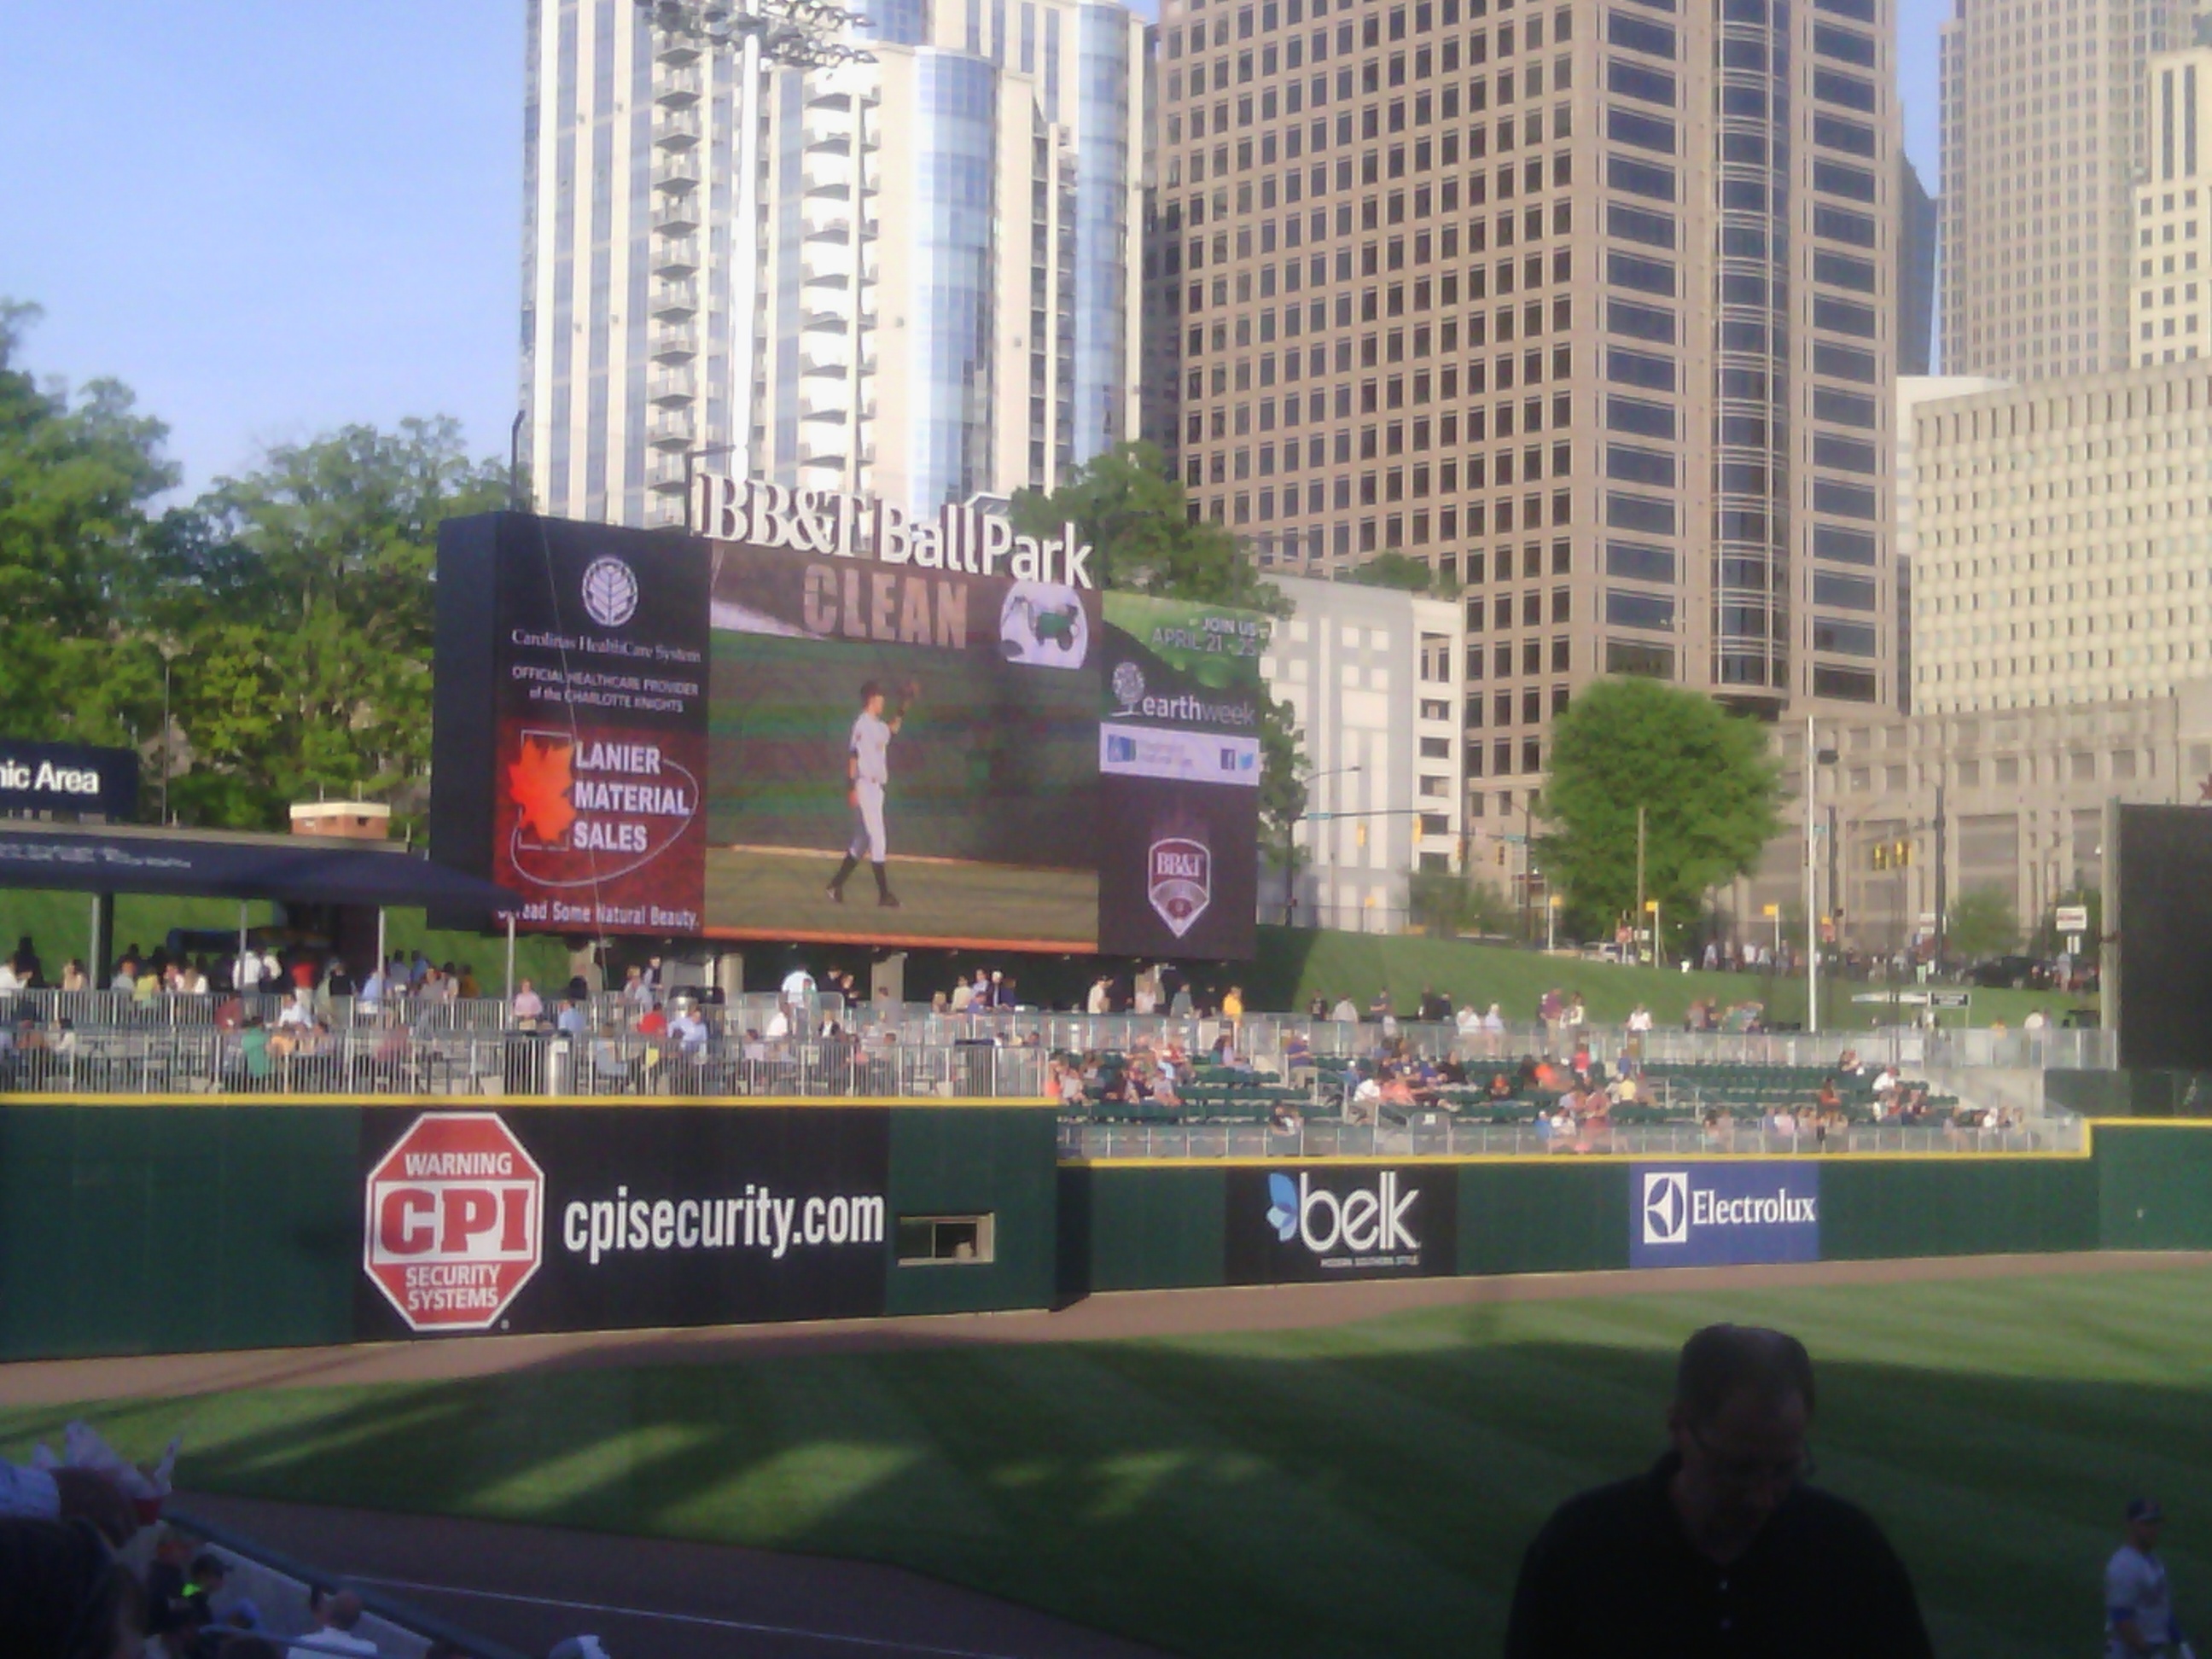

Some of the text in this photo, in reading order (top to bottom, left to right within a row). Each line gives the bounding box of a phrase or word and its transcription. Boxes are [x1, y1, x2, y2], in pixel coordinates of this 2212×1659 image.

[692, 473, 864, 555] BB&T
[804, 563, 968, 649] CLEAN
[512, 666, 564, 683] OFFICIAL
[575, 741, 661, 775] LANIER
[34, 760, 99, 795] Area
[574, 780, 690, 816] MATERIAL
[573, 820, 648, 852] SALES
[553, 900, 591, 923] Some
[597, 903, 647, 925] Natural
[405, 1153, 512, 1176] WARNING
[380, 1188, 530, 1255] CPI
[1300, 1171, 1420, 1254] belk
[1692, 1186, 1817, 1225] Electrolux
[563, 1183, 885, 1266] cpisecurity.com
[405, 1264, 502, 1288] SECURITY
[408, 1287, 499, 1312] SYSTEMS
